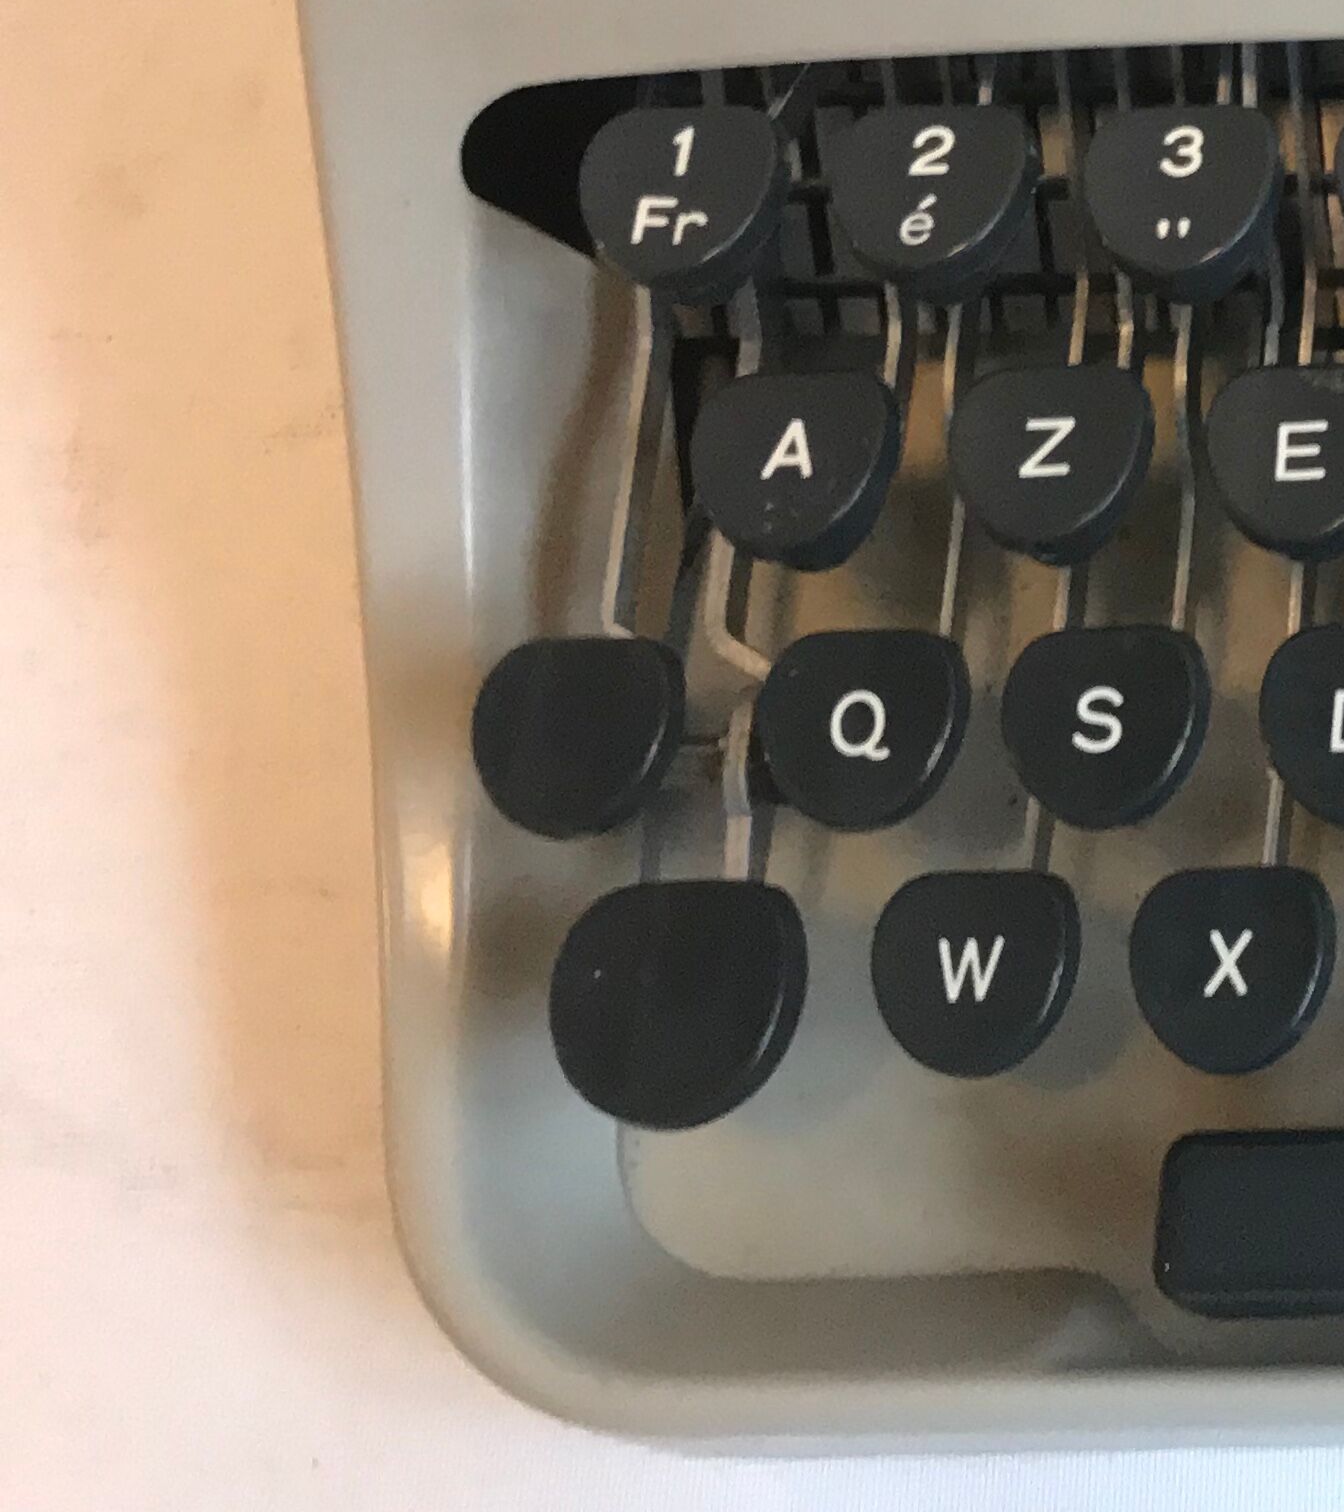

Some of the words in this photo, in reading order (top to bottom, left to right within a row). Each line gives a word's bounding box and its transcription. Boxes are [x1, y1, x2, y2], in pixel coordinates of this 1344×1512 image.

[671, 125, 696, 177] 1
[907, 124, 956, 177] 2
[1158, 124, 1205, 179] 3
[630, 195, 709, 246] Fr
[898, 193, 938, 246] é
[760, 417, 813, 481] A
[1017, 416, 1077, 480] Z
[1273, 419, 1330, 483] E
[829, 689, 891, 762] Q
[1071, 685, 1125, 754] S
[938, 935, 1006, 1004] W
[1203, 928, 1253, 998] X
